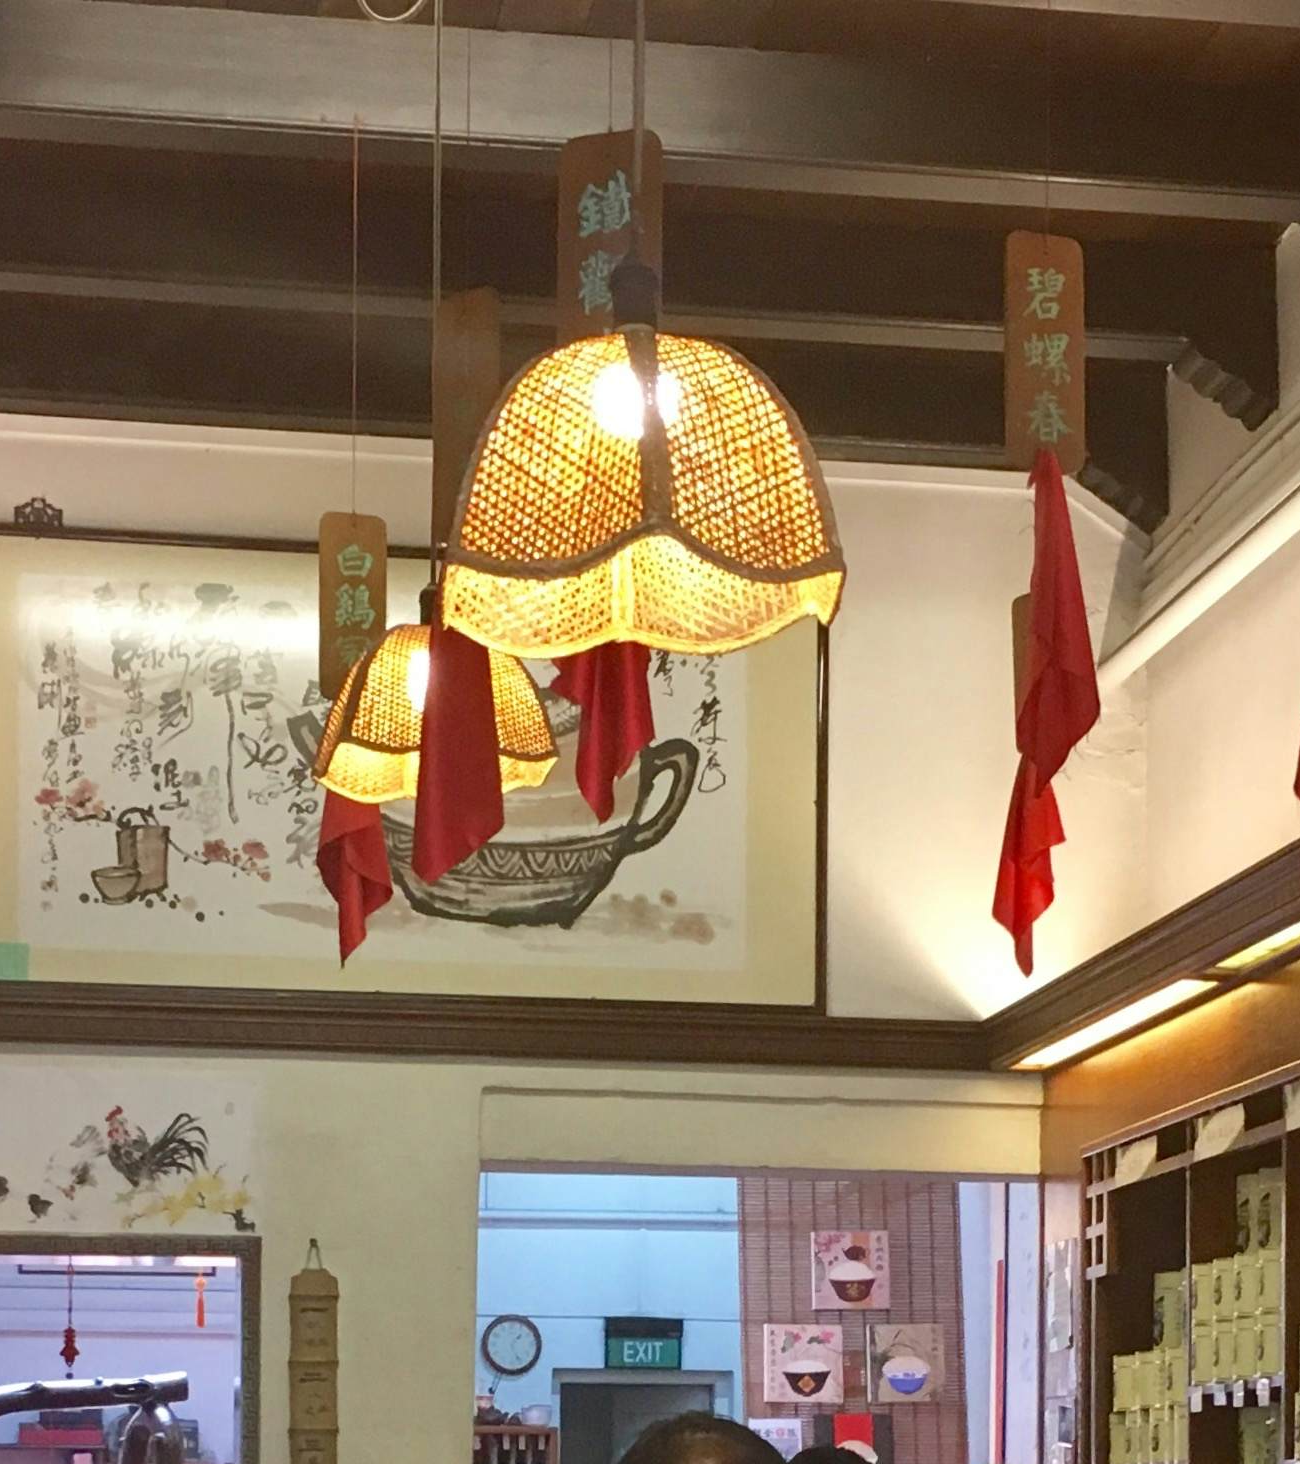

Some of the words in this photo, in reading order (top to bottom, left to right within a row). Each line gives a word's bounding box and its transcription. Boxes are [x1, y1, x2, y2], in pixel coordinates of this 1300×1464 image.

[578, 169, 631, 336] 鐵觀
[1022, 267, 1074, 444] 碧螺春
[623, 1340, 664, 1363] EXIT
